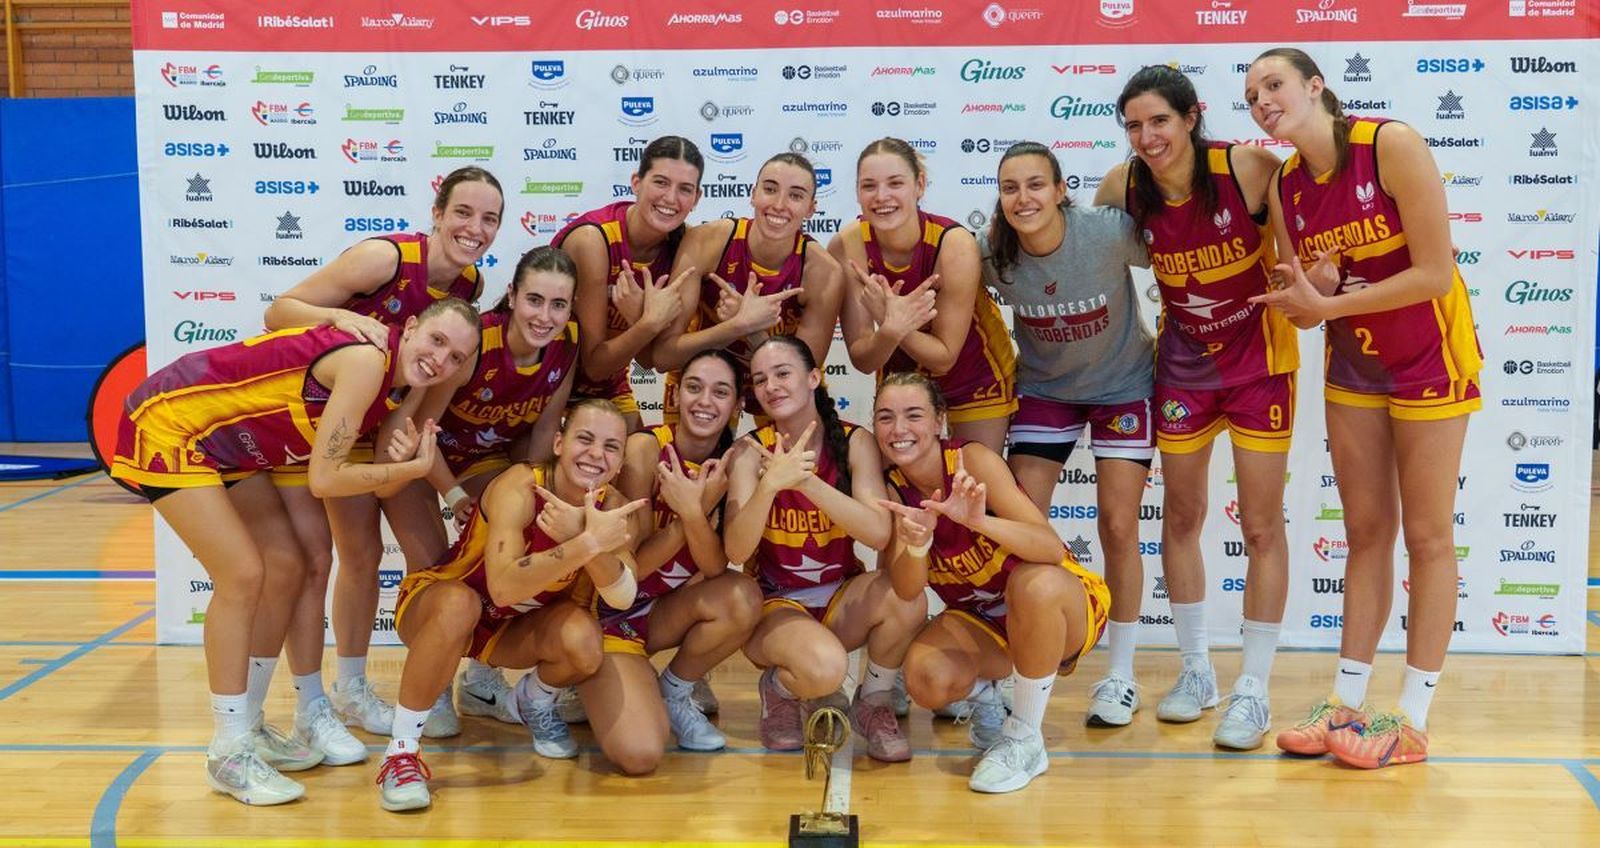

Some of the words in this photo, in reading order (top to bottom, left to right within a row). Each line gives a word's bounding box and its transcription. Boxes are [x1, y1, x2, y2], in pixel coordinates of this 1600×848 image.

[1102, 2, 1131, 10] PULEVA
[1542, 8, 1575, 16] Madrid
[575, 10, 629, 30] Ginos
[876, 8, 943, 19] azulmarino
[1008, 12, 1041, 22] queen
[1196, 10, 1247, 25] TENKEY
[1296, 8, 1357, 23] SPALDING
[180, 21, 191, 29] de
[194, 20, 224, 29] Madrid
[471, 16, 531, 26] VIPS
[178, 66, 197, 74] FBM
[534, 64, 562, 73] PULEVA
[960, 59, 1026, 83] Ginos
[1052, 65, 1116, 74] VIPS
[1417, 58, 1469, 73] asisa
[1510, 56, 1577, 73] Wilson
[693, 66, 758, 77] azulmarino
[344, 75, 397, 88] SPALDING
[434, 75, 485, 89] TENKEY
[269, 104, 288, 113] FBM
[623, 100, 652, 109] PULEVA
[782, 101, 847, 112] azulmarino
[1050, 96, 1115, 120] Ginos
[1340, 101, 1386, 110] béSalat
[1510, 96, 1563, 110] asisa
[163, 104, 226, 121] Wilson
[434, 112, 487, 125] SPALDING
[524, 111, 575, 125] TENKEY
[359, 142, 378, 150] FBM
[713, 137, 741, 145] PULEVA
[165, 142, 215, 156] asisa
[253, 143, 316, 159] Wilson
[524, 148, 576, 160] SPALDING
[613, 147, 645, 161] TEN
[961, 175, 996, 185] azulm
[255, 180, 305, 194] asisa
[343, 180, 405, 196] Wilson
[702, 184, 753, 198] TENKEY
[538, 214, 557, 222] FBM
[1448, 213, 1483, 222] PS
[345, 218, 395, 231] asisa
[800, 219, 842, 233] ENKEY
[1152, 237, 1247, 274] COBENDAS
[1508, 250, 1574, 259] VIPS
[173, 291, 236, 301] VIPS
[1505, 280, 1573, 304] Ginos
[174, 320, 237, 344] Ginos
[1355, 328, 1379, 355] 2
[1502, 397, 1570, 407] azulmarino
[1269, 405, 1282, 430] 9
[1517, 467, 1547, 476] PULEVA
[1504, 514, 1556, 527] TENKEY
[1500, 550, 1555, 563] SPALDING
[1312, 578, 1344, 593] Wil
[1510, 615, 1529, 623] FBM
